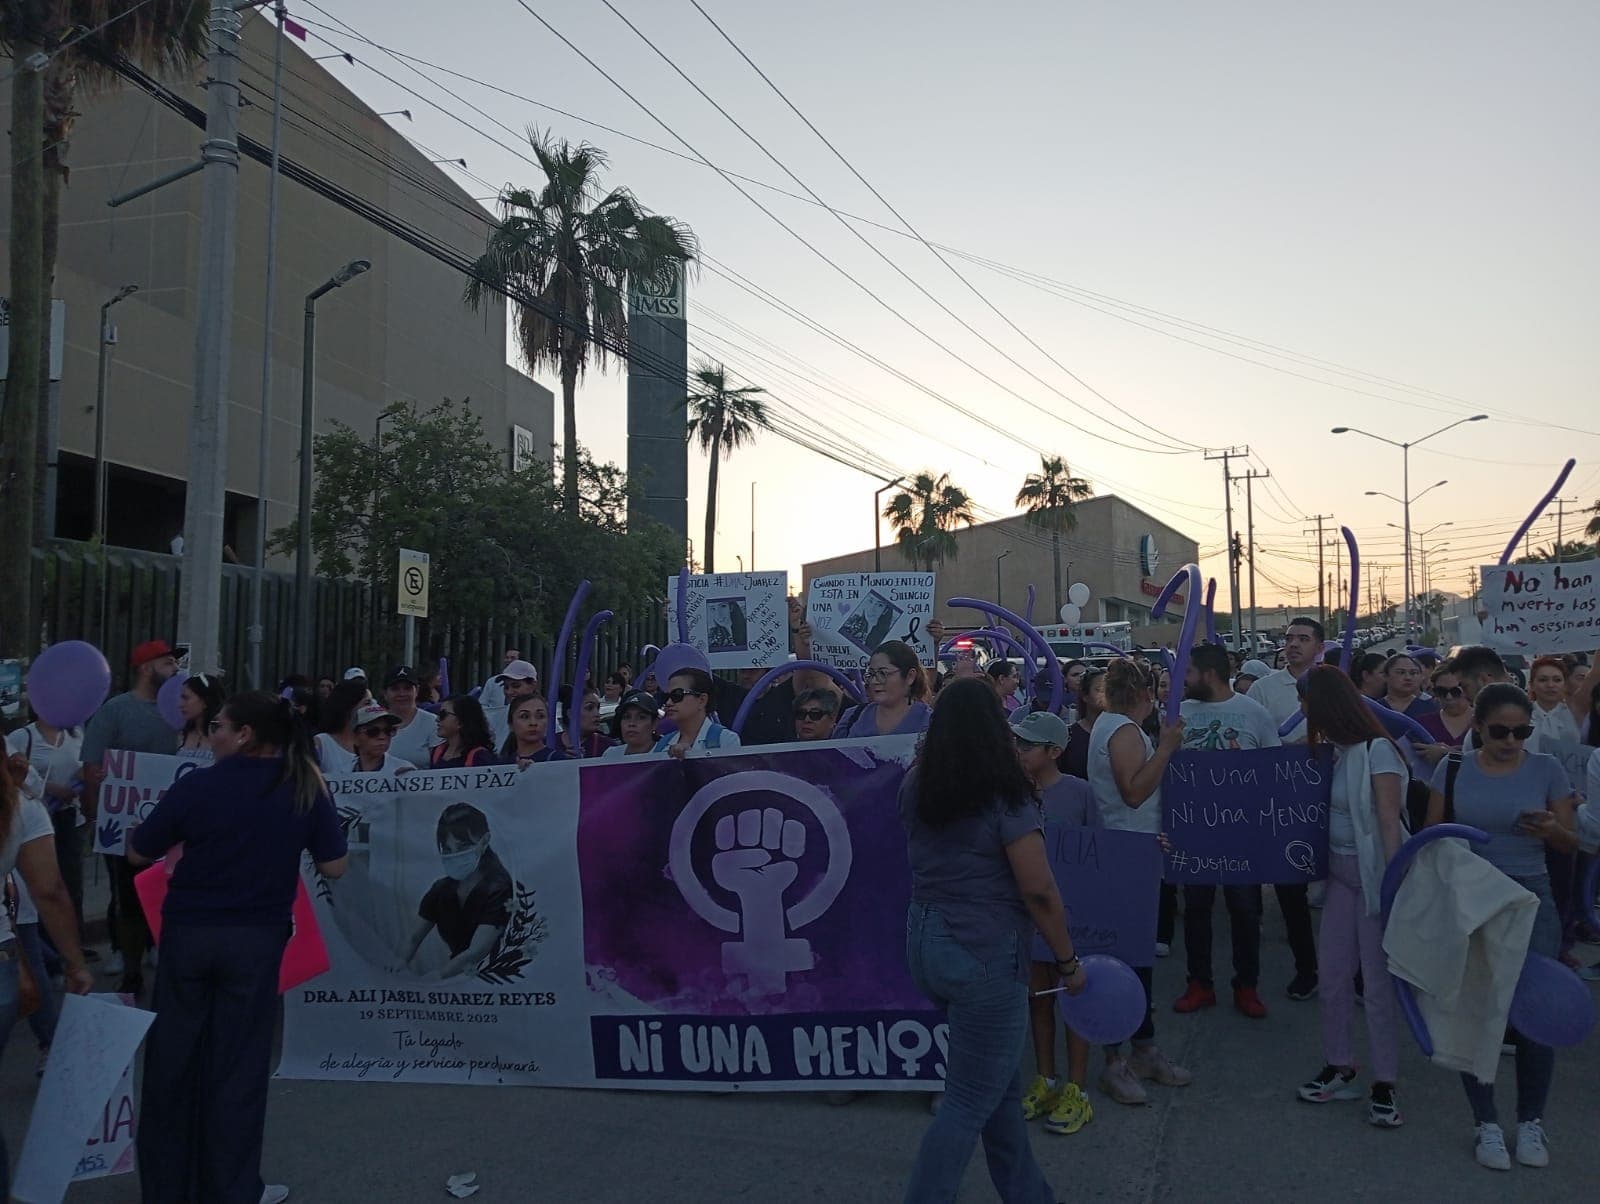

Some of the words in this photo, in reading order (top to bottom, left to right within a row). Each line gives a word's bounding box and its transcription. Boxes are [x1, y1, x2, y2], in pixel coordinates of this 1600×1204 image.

[635, 294, 679, 315] IMSS
[861, 574, 893, 588] MUNDO
[1504, 570, 1540, 594] No
[1554, 566, 1592, 590] han
[812, 602, 833, 613] UNA
[907, 603, 930, 615] SOLA
[1501, 597, 1564, 613] muerto
[814, 616, 832, 630] VOZ
[1494, 616, 1520, 634] han
[104, 750, 136, 780] NI
[1169, 763, 1196, 788] Ni
[1274, 759, 1322, 793] MAS
[329, 776, 434, 794] DESCANSE
[440, 774, 467, 791] EN
[475, 771, 517, 789] PAZ
[1171, 801, 1195, 829] Ni
[1203, 801, 1249, 827] Una
[1259, 797, 1329, 838] MENOS
[303, 990, 344, 1004] DRA.
[350, 989, 378, 1003] ALI
[428, 992, 494, 1006] SUAREZ
[500, 991, 556, 1006] REYES
[360, 1010, 374, 1020] 19
[378, 1009, 465, 1023] SEPTIEMBRE
[467, 1013, 499, 1024] 2023
[393, 1030, 416, 1050] Tú
[419, 1030, 465, 1058] legado
[679, 1023, 772, 1074] UNA
[320, 1053, 340, 1072] de
[394, 1058, 412, 1079] y
[413, 1056, 467, 1070] servicio
